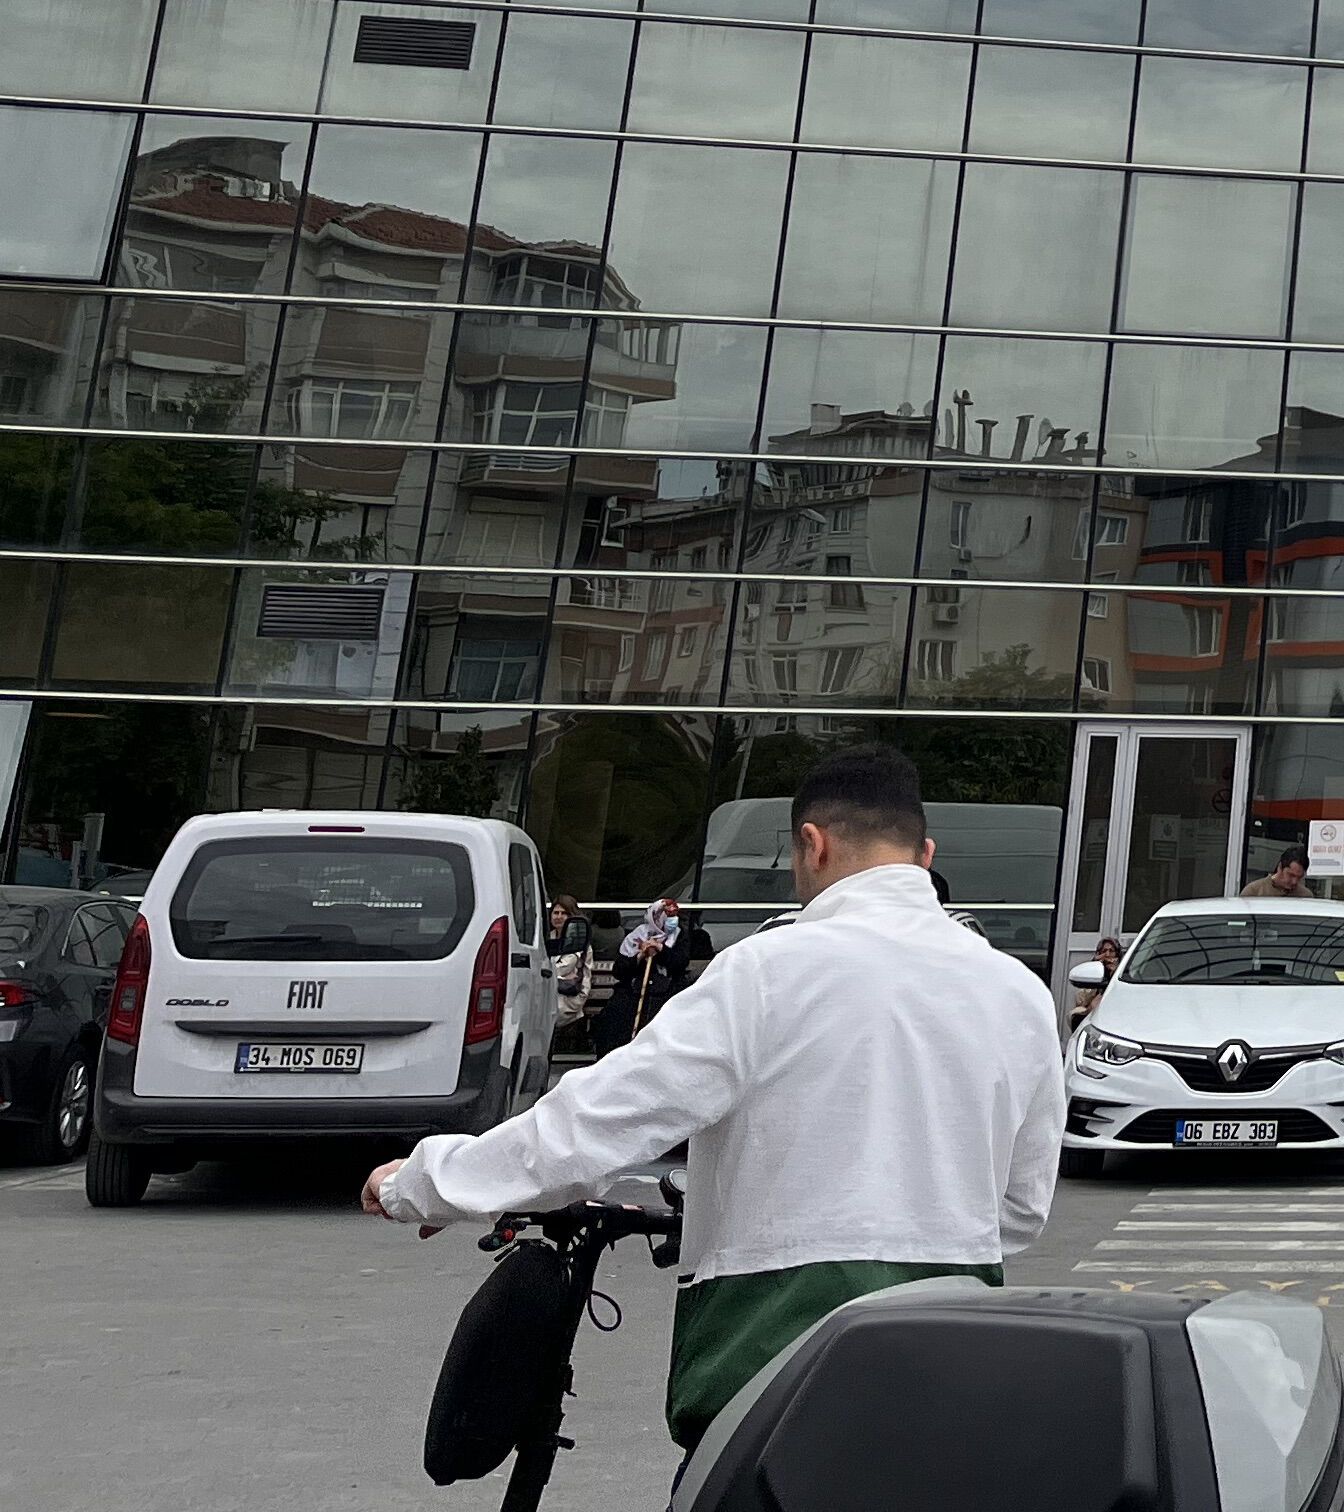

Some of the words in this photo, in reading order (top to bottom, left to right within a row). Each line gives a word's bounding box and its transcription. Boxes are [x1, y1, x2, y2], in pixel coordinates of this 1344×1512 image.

[166, 999, 229, 1007] DOBLO
[286, 981, 328, 1009] FIAT
[249, 1047, 271, 1066] 34
[280, 1047, 315, 1066] MOS
[322, 1047, 357, 1066] 069
[1184, 1123, 1203, 1140] 06
[1212, 1123, 1240, 1139] EBZ
[1248, 1123, 1276, 1139] 383
